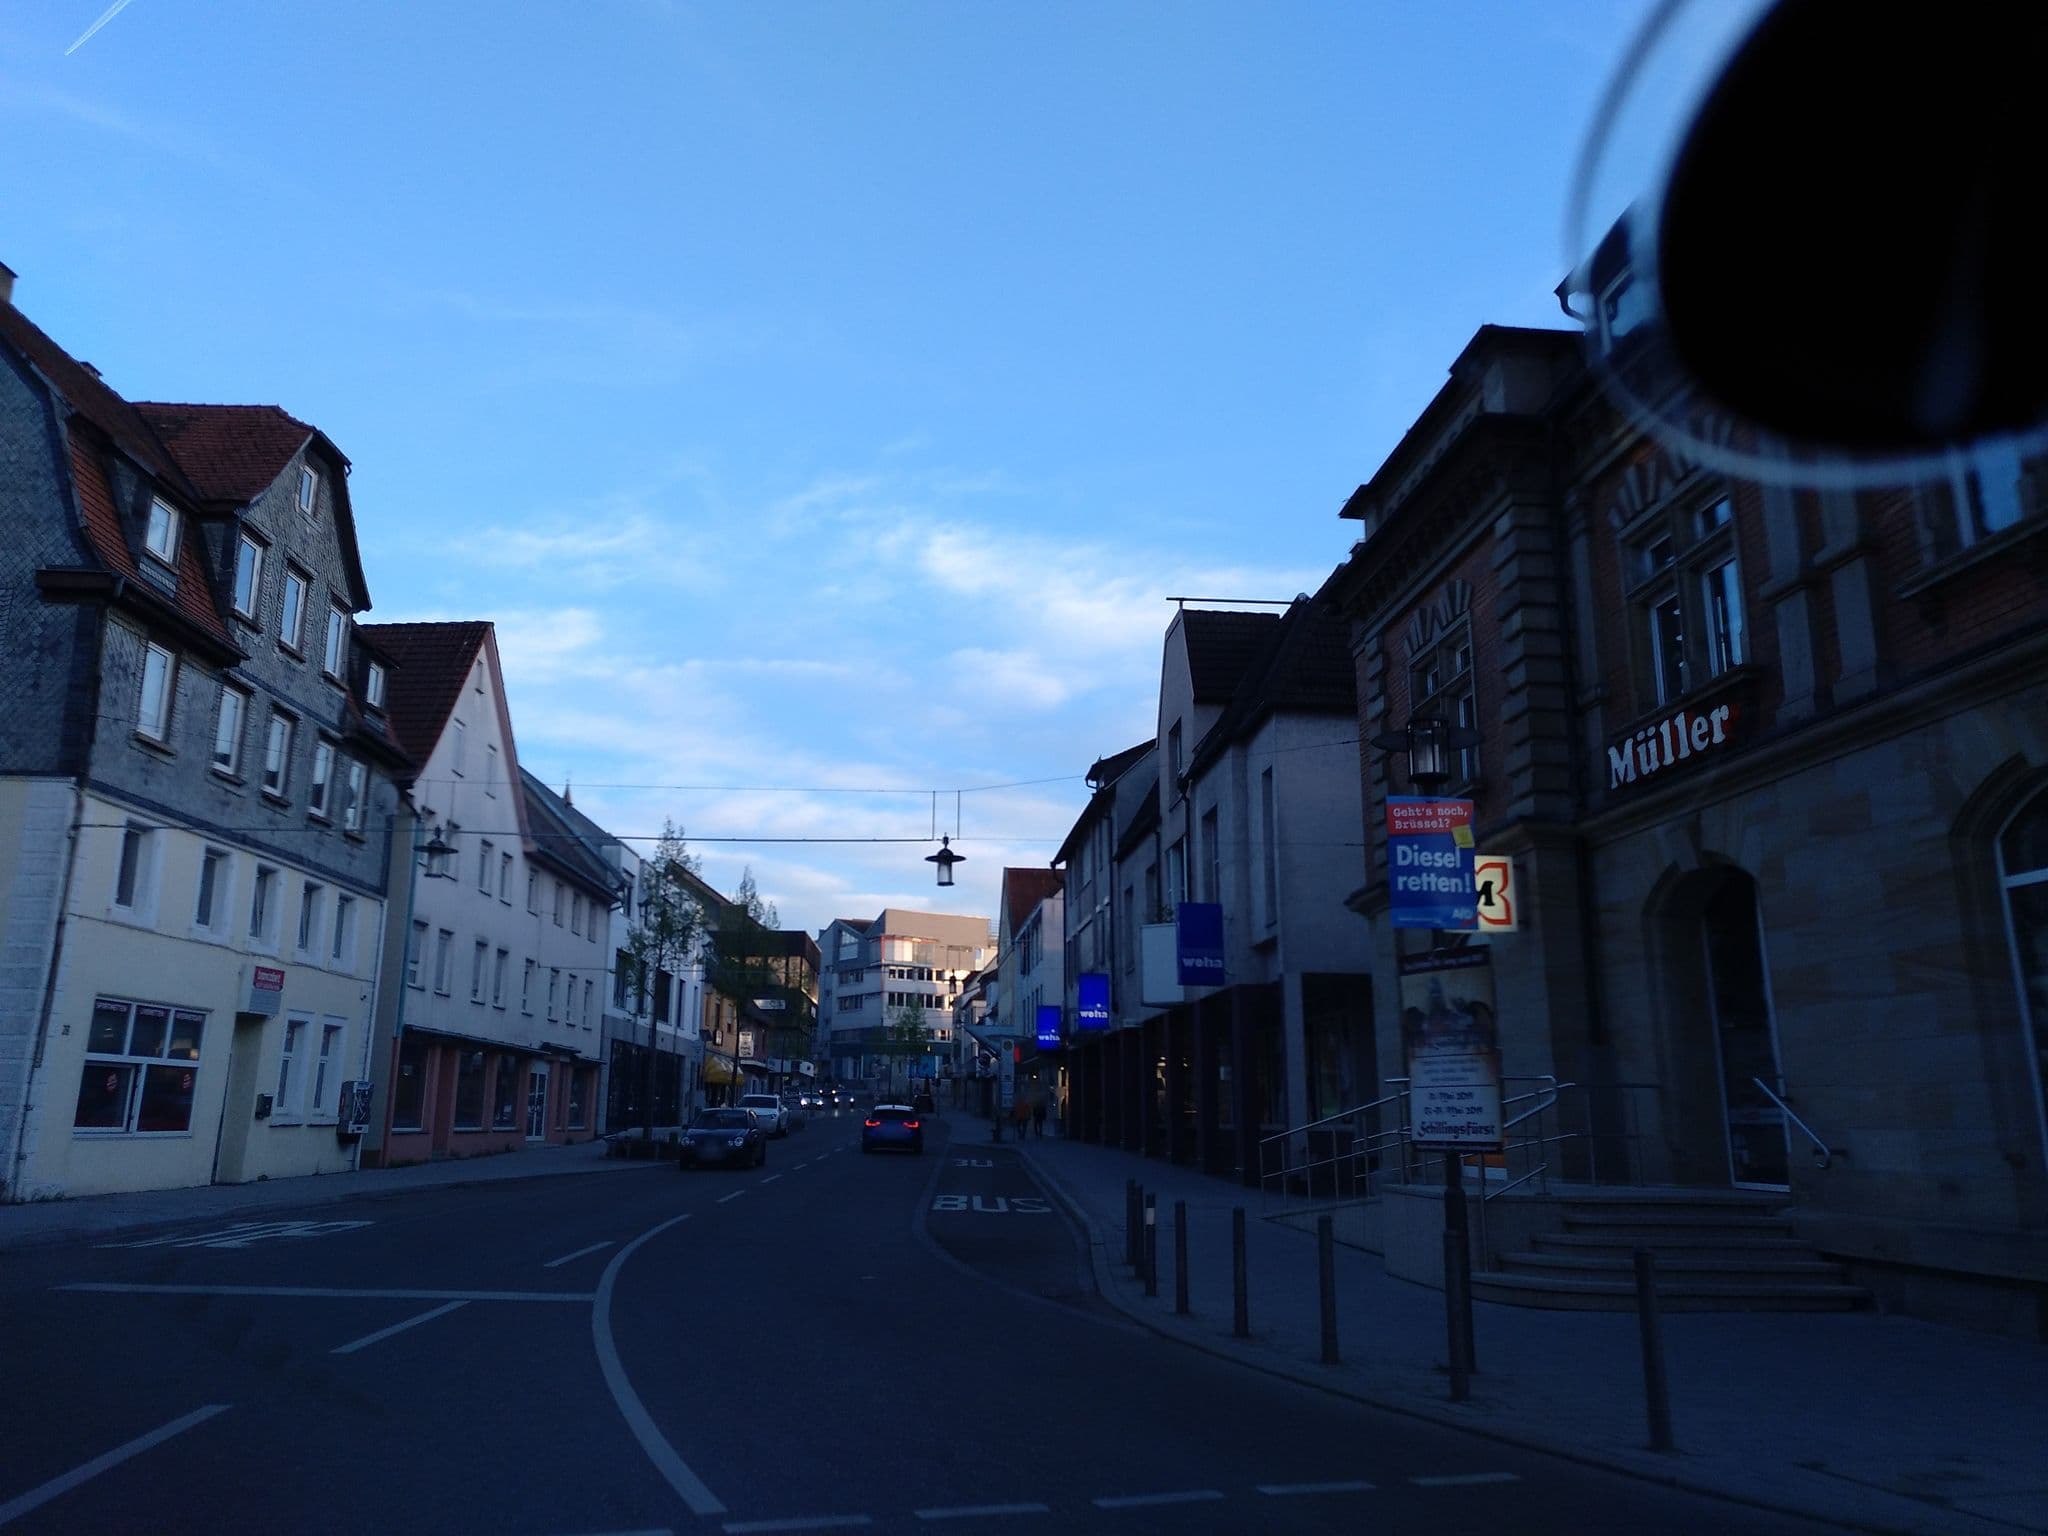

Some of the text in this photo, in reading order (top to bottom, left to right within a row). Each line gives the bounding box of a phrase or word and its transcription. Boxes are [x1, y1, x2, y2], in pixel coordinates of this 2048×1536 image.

[1607, 704, 1730, 790] Müller
[1393, 806, 1468, 817] Geht's noch,
[1395, 819, 1450, 829] Brüssel?
[1396, 844, 1460, 868] Diesel
[1396, 872, 1472, 894] retten!
[1182, 956, 1223, 968] weha
[1079, 1005, 1108, 1018] weha
[931, 1195, 1052, 1213] BUS
